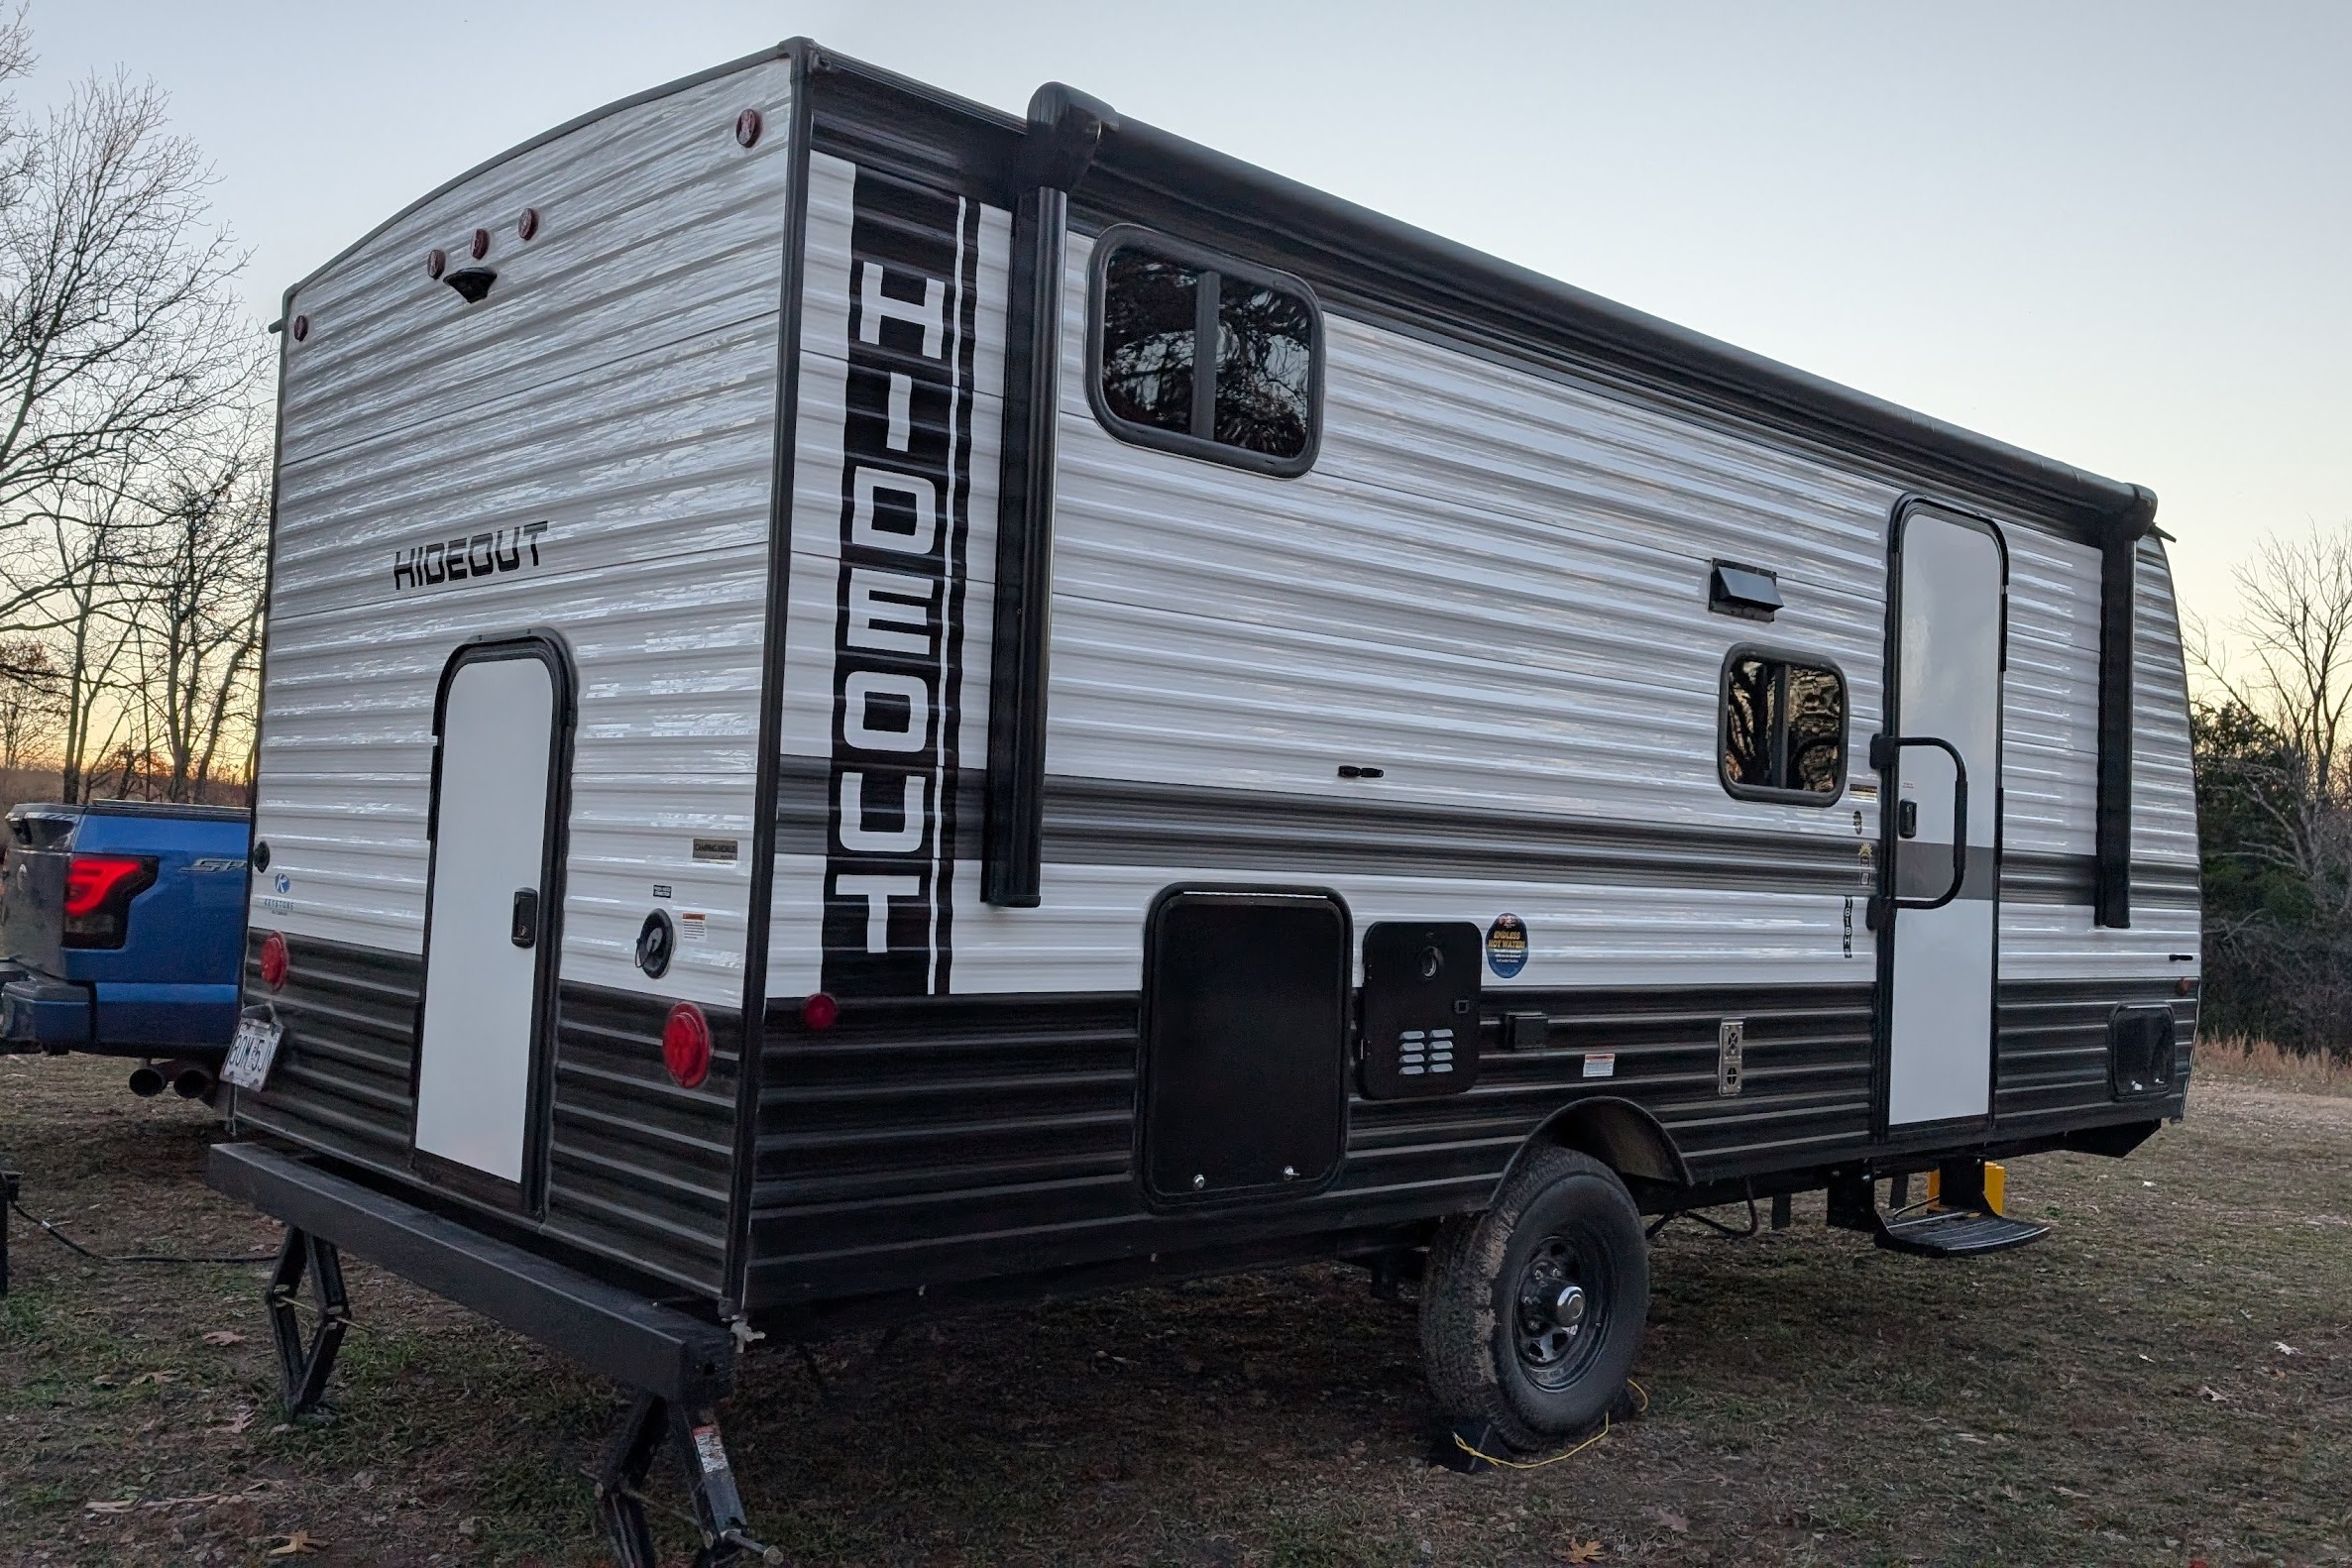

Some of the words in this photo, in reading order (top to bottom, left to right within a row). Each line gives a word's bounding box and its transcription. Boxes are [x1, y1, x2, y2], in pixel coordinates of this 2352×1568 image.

[393, 520, 548, 591] HIDEOUT
[836, 261, 945, 953] HIDEOUT
[264, 898, 294, 911] KEYSTONE
[1493, 930, 1521, 940] ENDLESS
[1488, 939, 1502, 949] HOT
